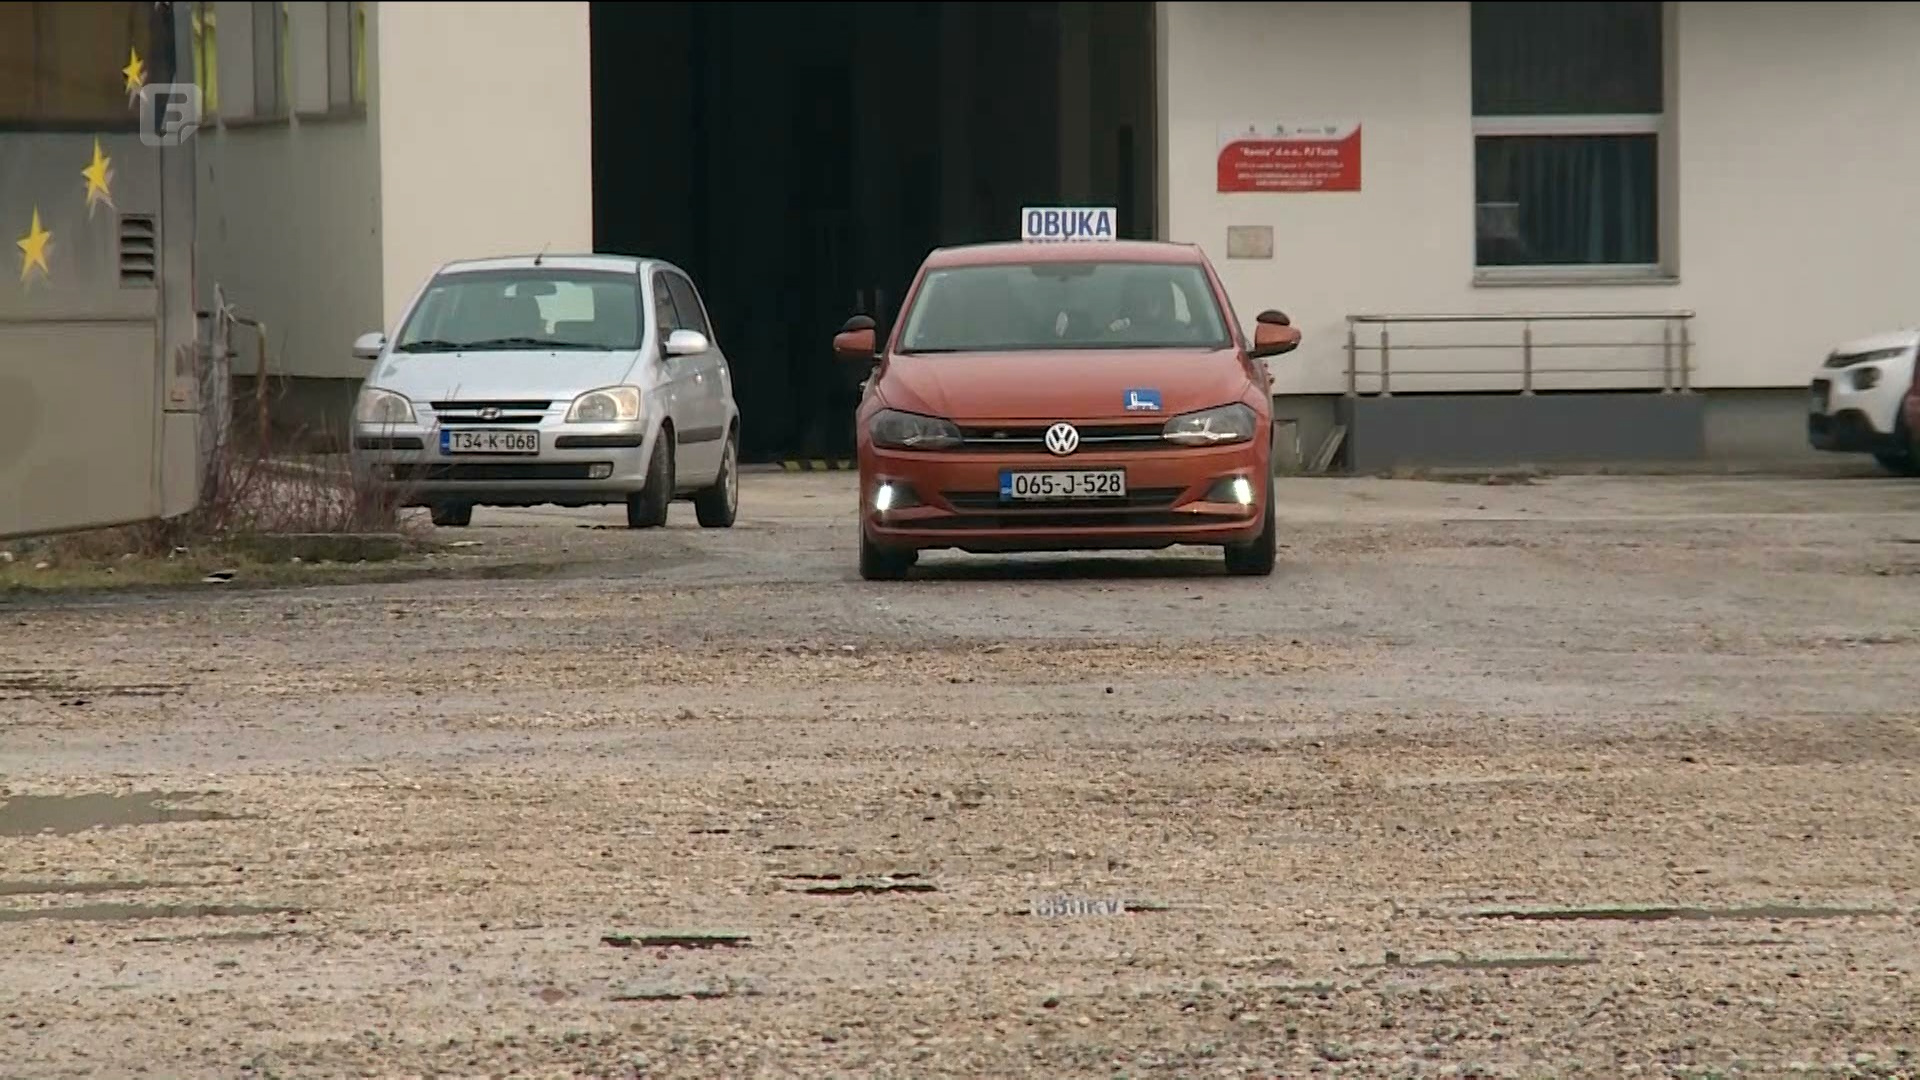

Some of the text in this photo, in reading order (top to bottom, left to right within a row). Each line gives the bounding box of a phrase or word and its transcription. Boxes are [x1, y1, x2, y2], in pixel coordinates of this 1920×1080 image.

[1027, 210, 1112, 237] OBUKA
[452, 432, 536, 450] T34-K-068
[1045, 422, 1080, 455] VW
[1015, 474, 1121, 495] 065-J-528
